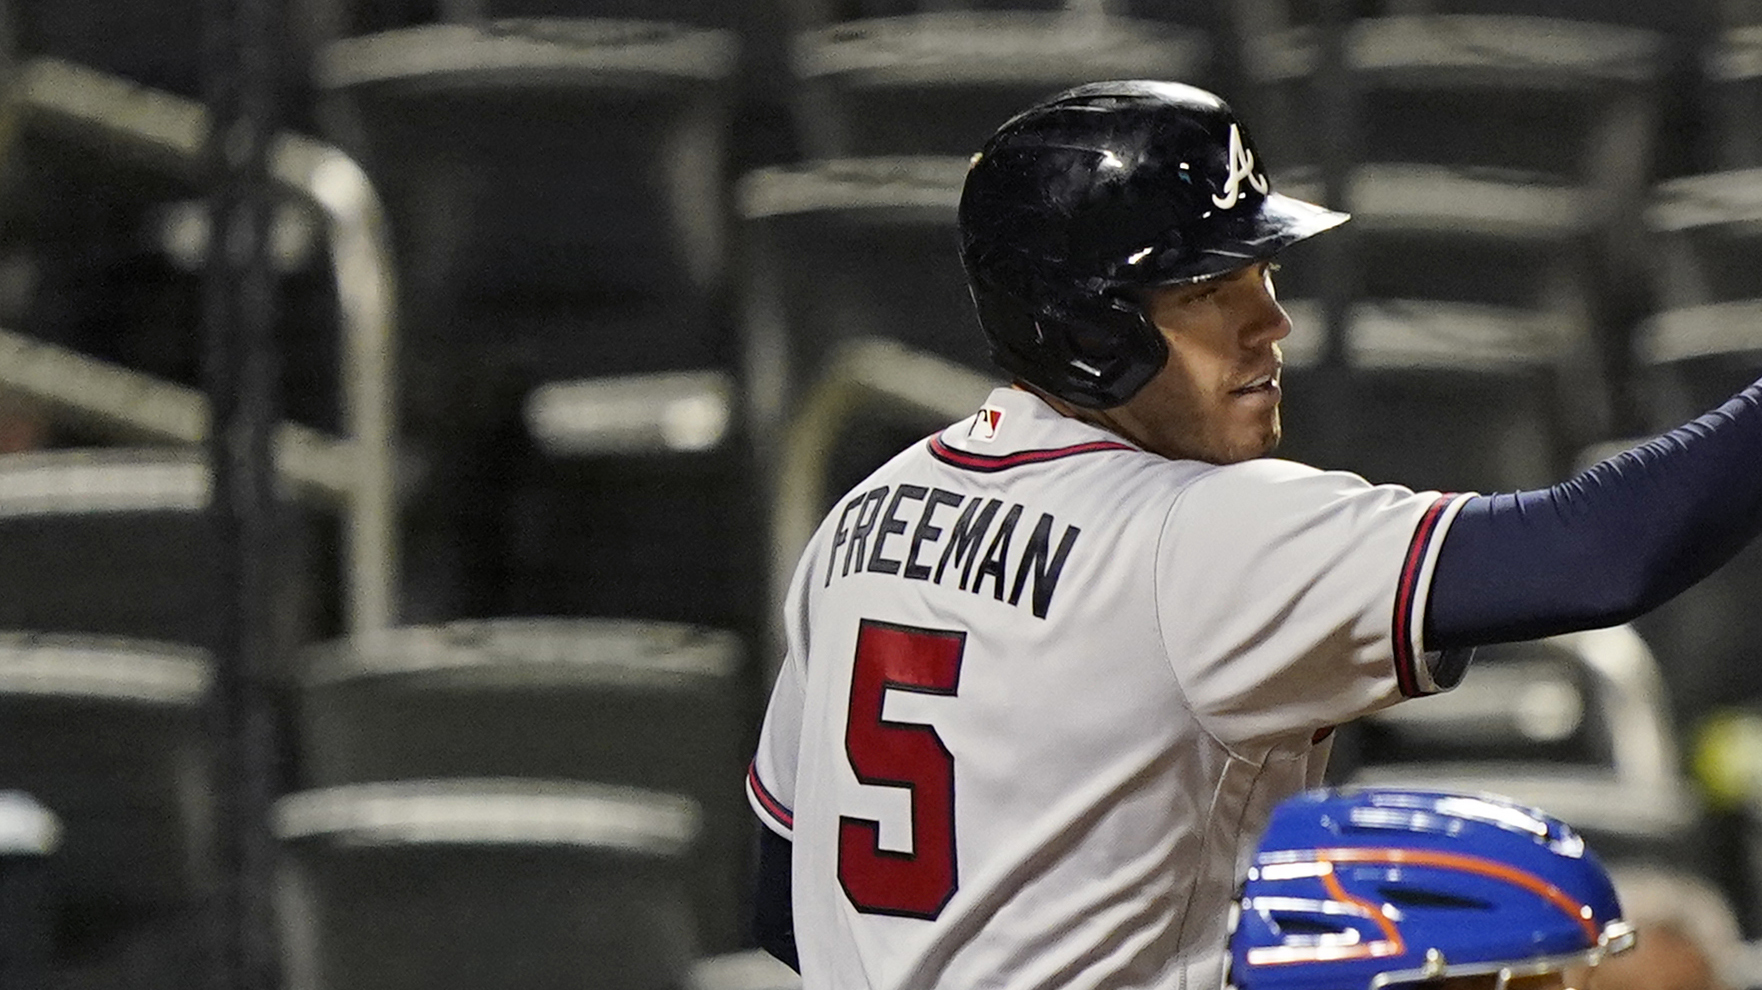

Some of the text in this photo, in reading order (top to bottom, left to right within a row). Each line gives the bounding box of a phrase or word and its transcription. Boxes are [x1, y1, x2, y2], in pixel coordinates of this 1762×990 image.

[1211, 123, 1268, 210] A
[824, 483, 1081, 620] FREEMAN
[837, 617, 968, 922] 5
